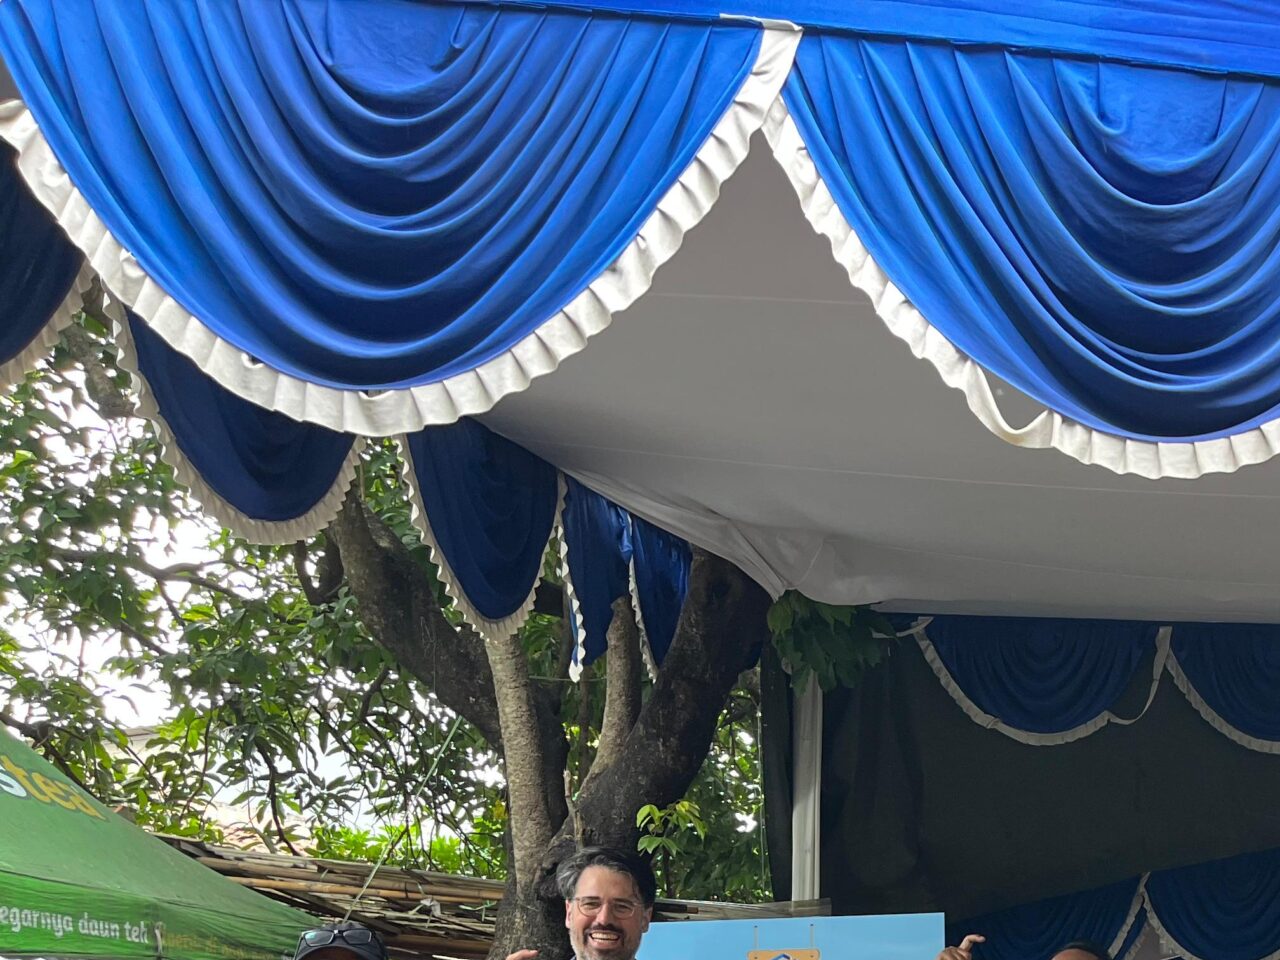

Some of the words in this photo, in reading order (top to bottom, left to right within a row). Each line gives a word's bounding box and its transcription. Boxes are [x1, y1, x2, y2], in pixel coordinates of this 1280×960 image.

[0, 755, 107, 821] stea
[0, 906, 74, 938] egarnya
[79, 912, 120, 940] daun
[124, 921, 149, 944] teh
